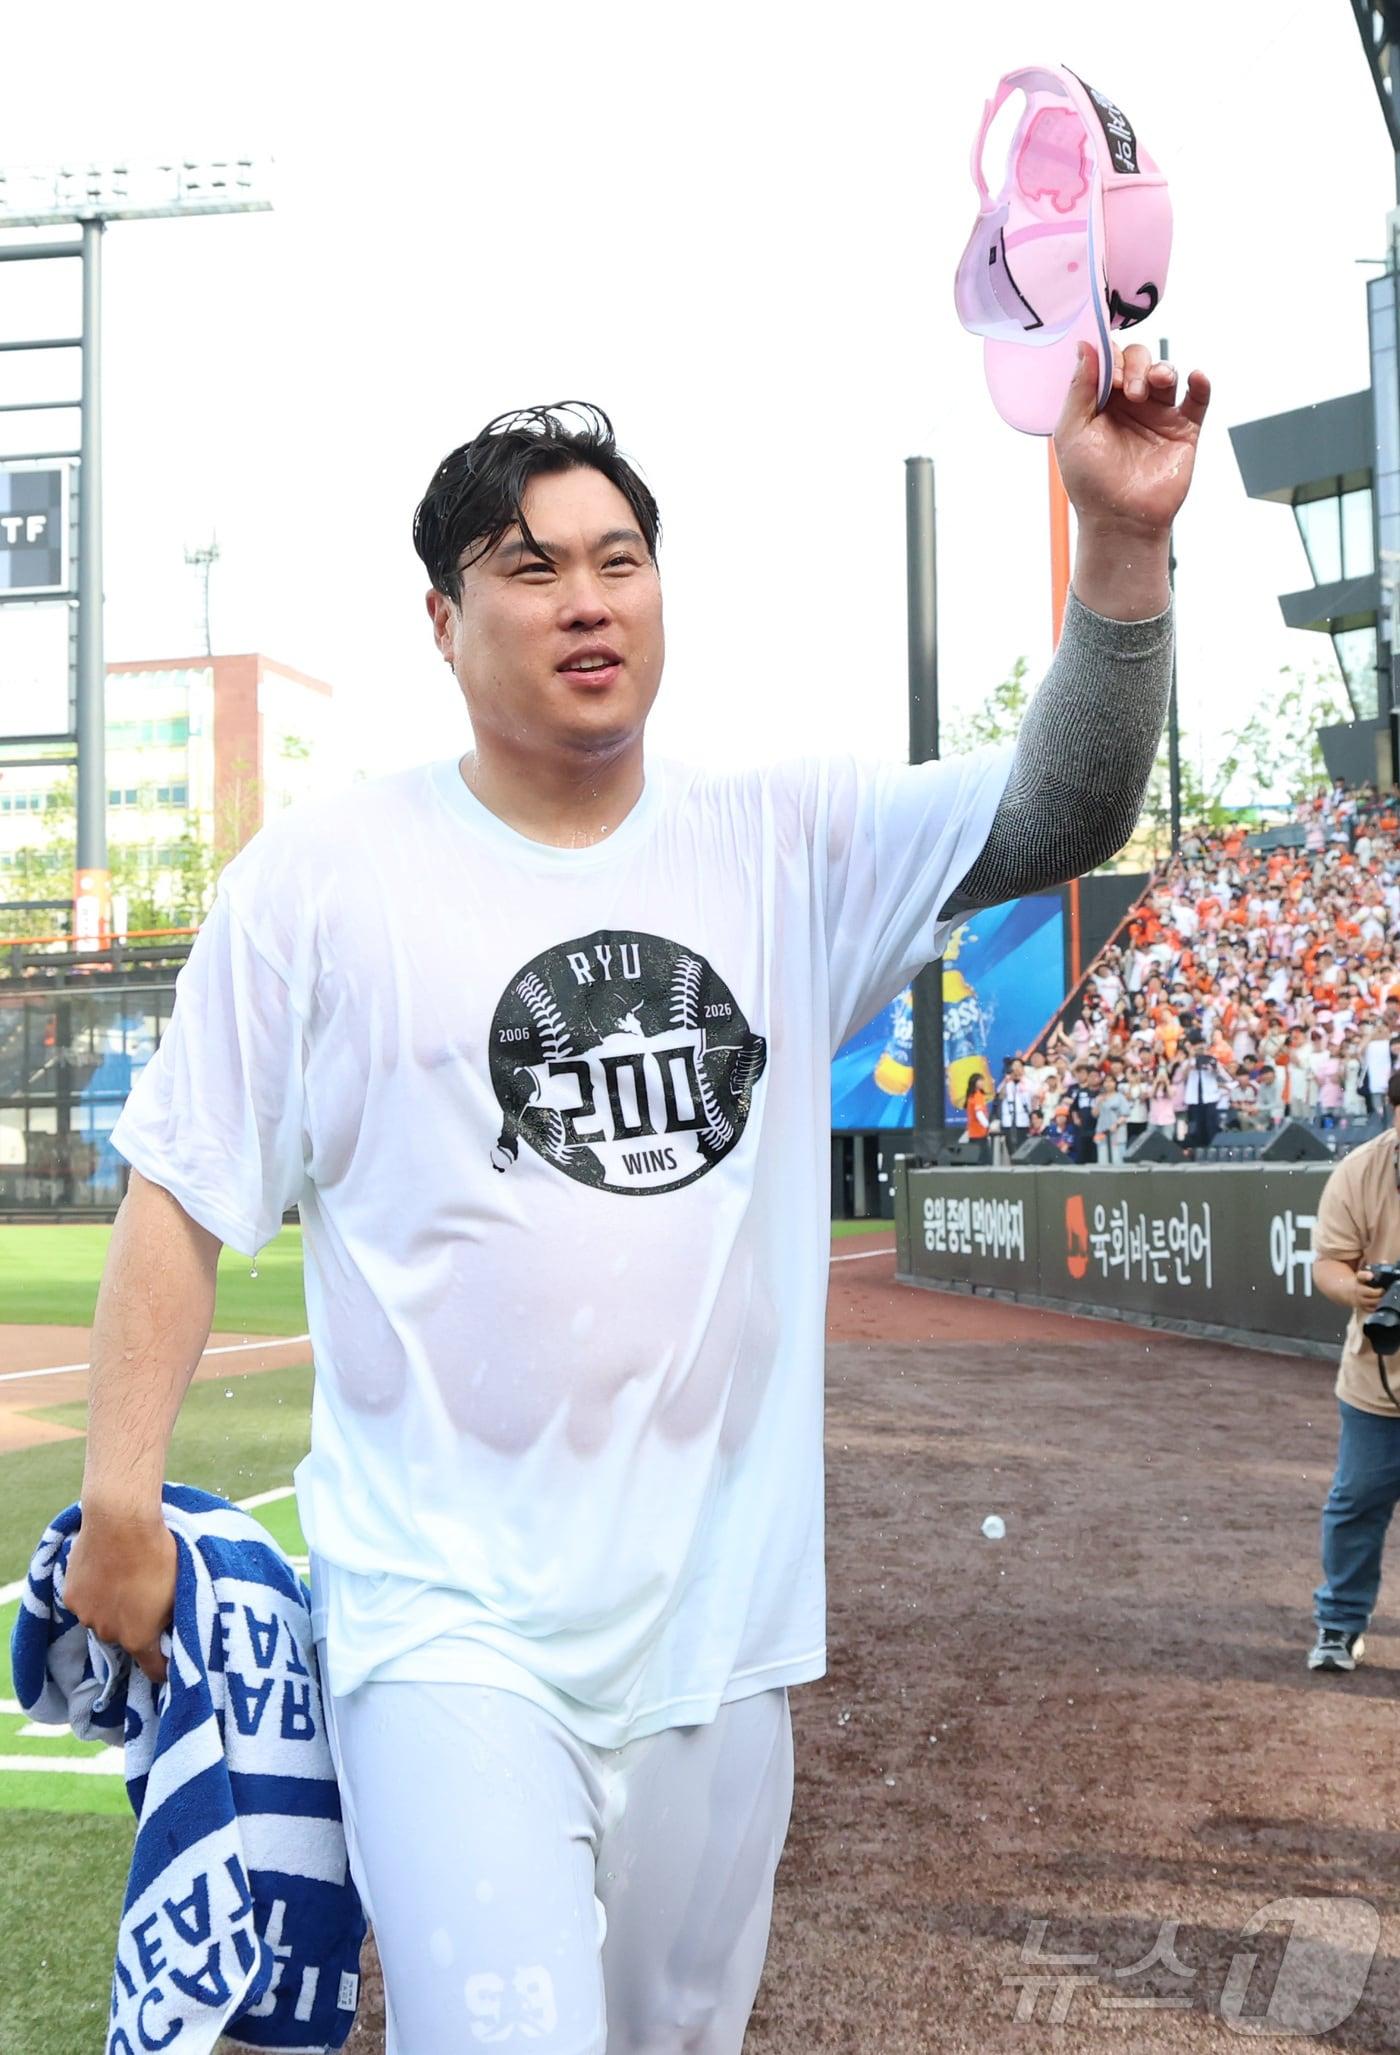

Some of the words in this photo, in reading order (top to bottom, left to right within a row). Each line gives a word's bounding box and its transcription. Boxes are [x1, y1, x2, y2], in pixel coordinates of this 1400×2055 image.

[566, 943, 641, 985] RYU
[704, 1003, 732, 1018] 2026
[499, 1027, 530, 1043] 2006
[547, 1046, 709, 1147] 200
[622, 1148, 678, 1175] WINS
[1089, 1200, 1212, 1289] 육회바른연어
